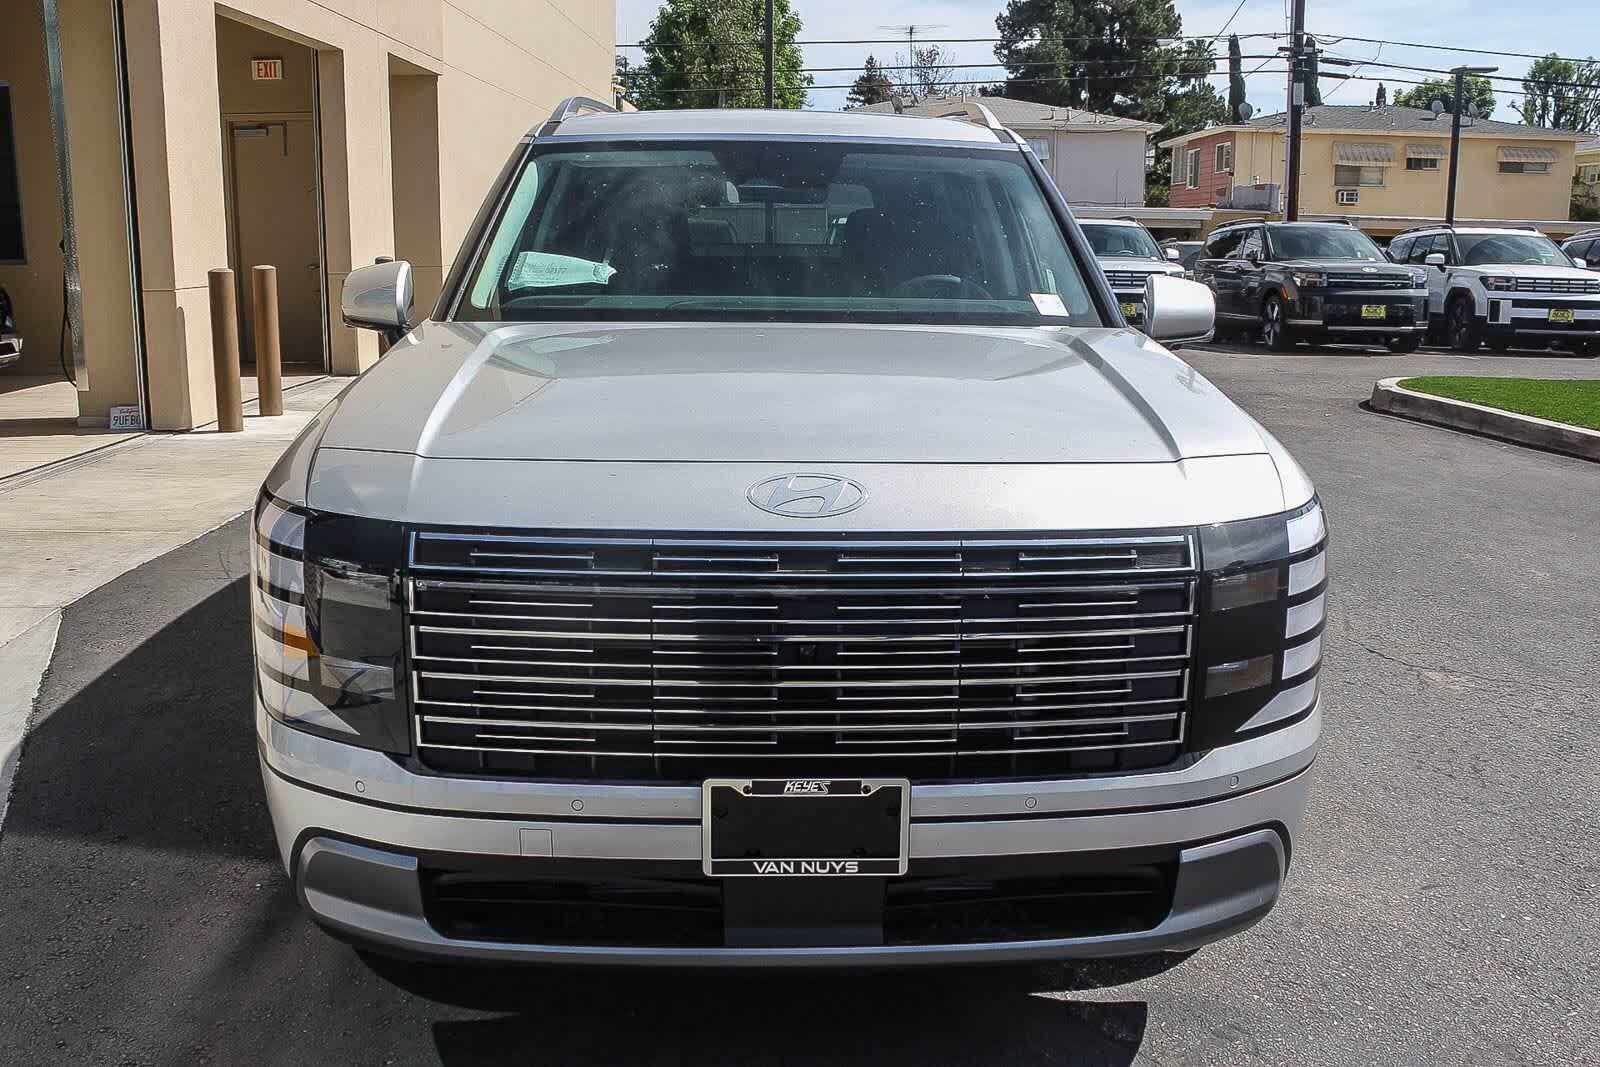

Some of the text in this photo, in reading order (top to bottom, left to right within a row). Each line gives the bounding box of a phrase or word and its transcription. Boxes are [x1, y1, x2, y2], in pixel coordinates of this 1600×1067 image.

[257, 61, 279, 78] EXIT
[784, 780, 831, 794] KEYES
[753, 861, 859, 873] VAN NUYS
